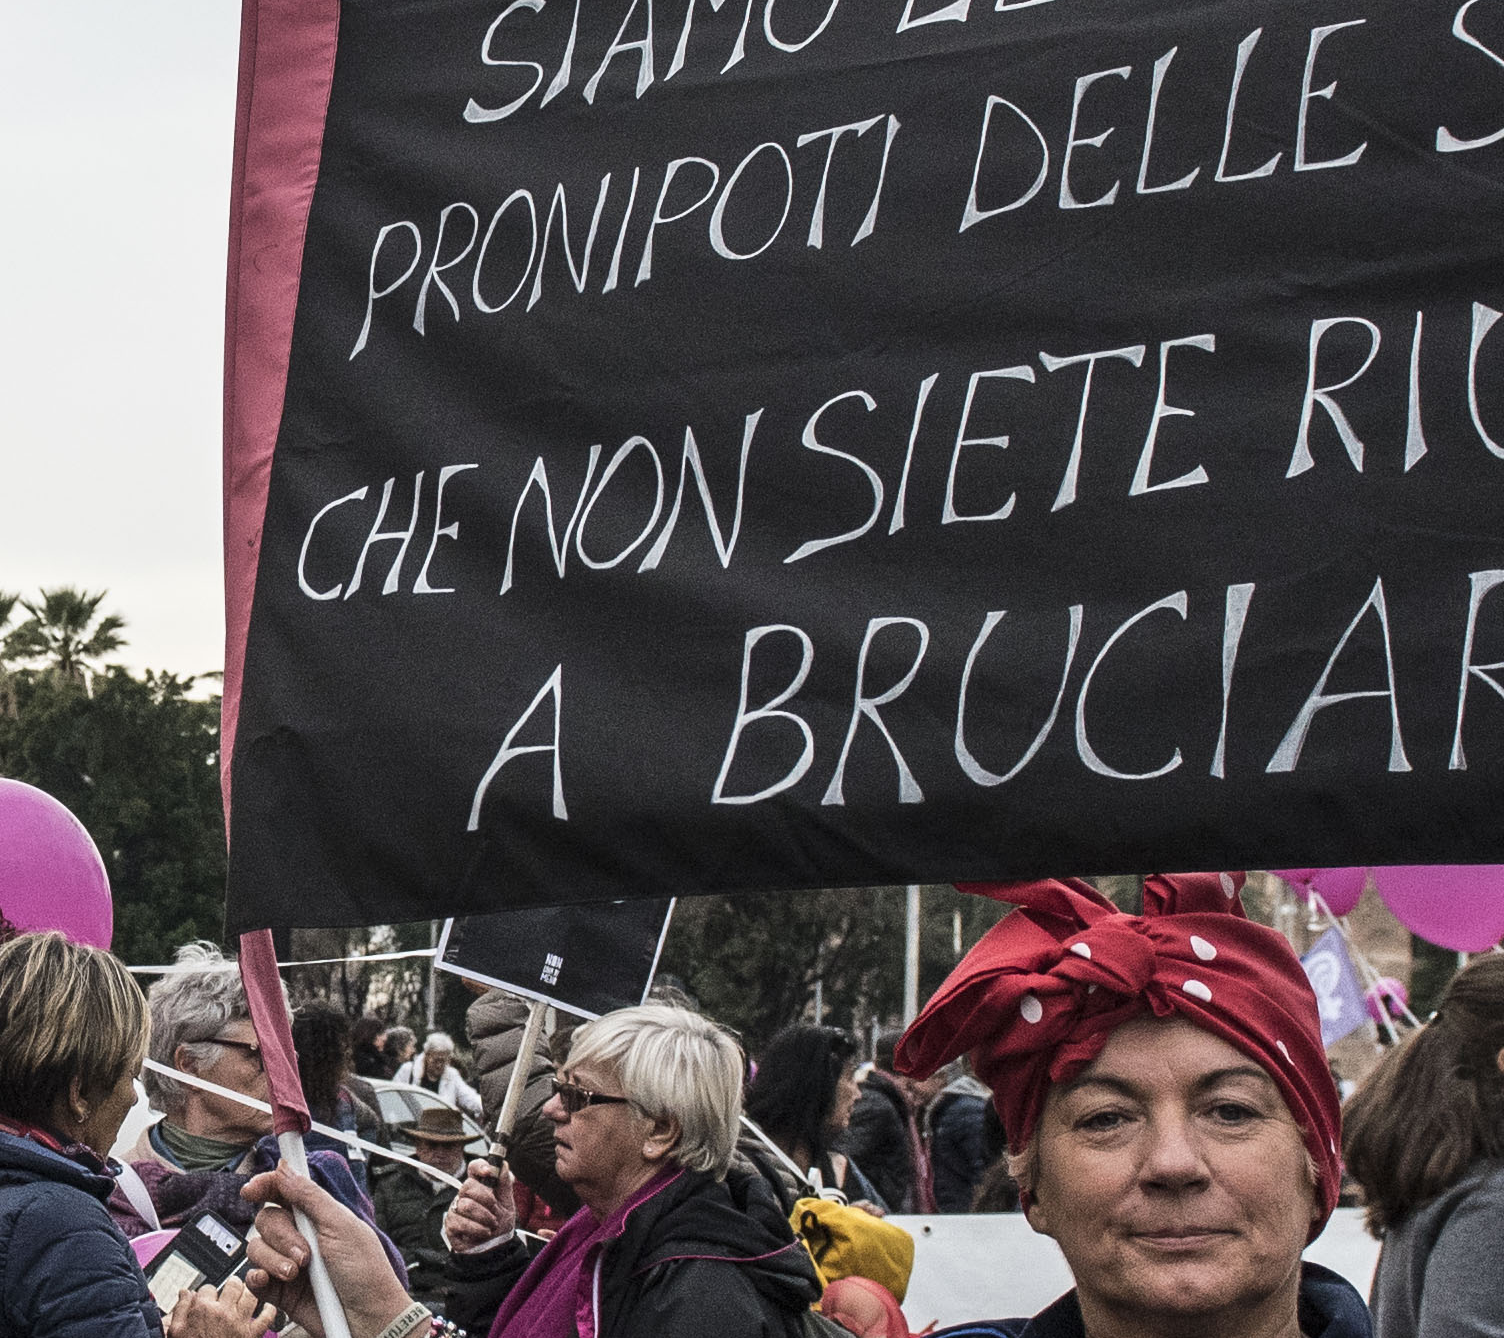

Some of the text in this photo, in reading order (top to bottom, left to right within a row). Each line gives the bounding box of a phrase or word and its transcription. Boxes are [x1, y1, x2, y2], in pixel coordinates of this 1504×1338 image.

[348, 113, 902, 363] PRONIPOTI
[958, 17, 1368, 235] DELLE
[296, 462, 481, 603] CHE
[498, 406, 765, 597] NON
[782, 332, 1217, 565] SIETE
[465, 662, 569, 832] A
